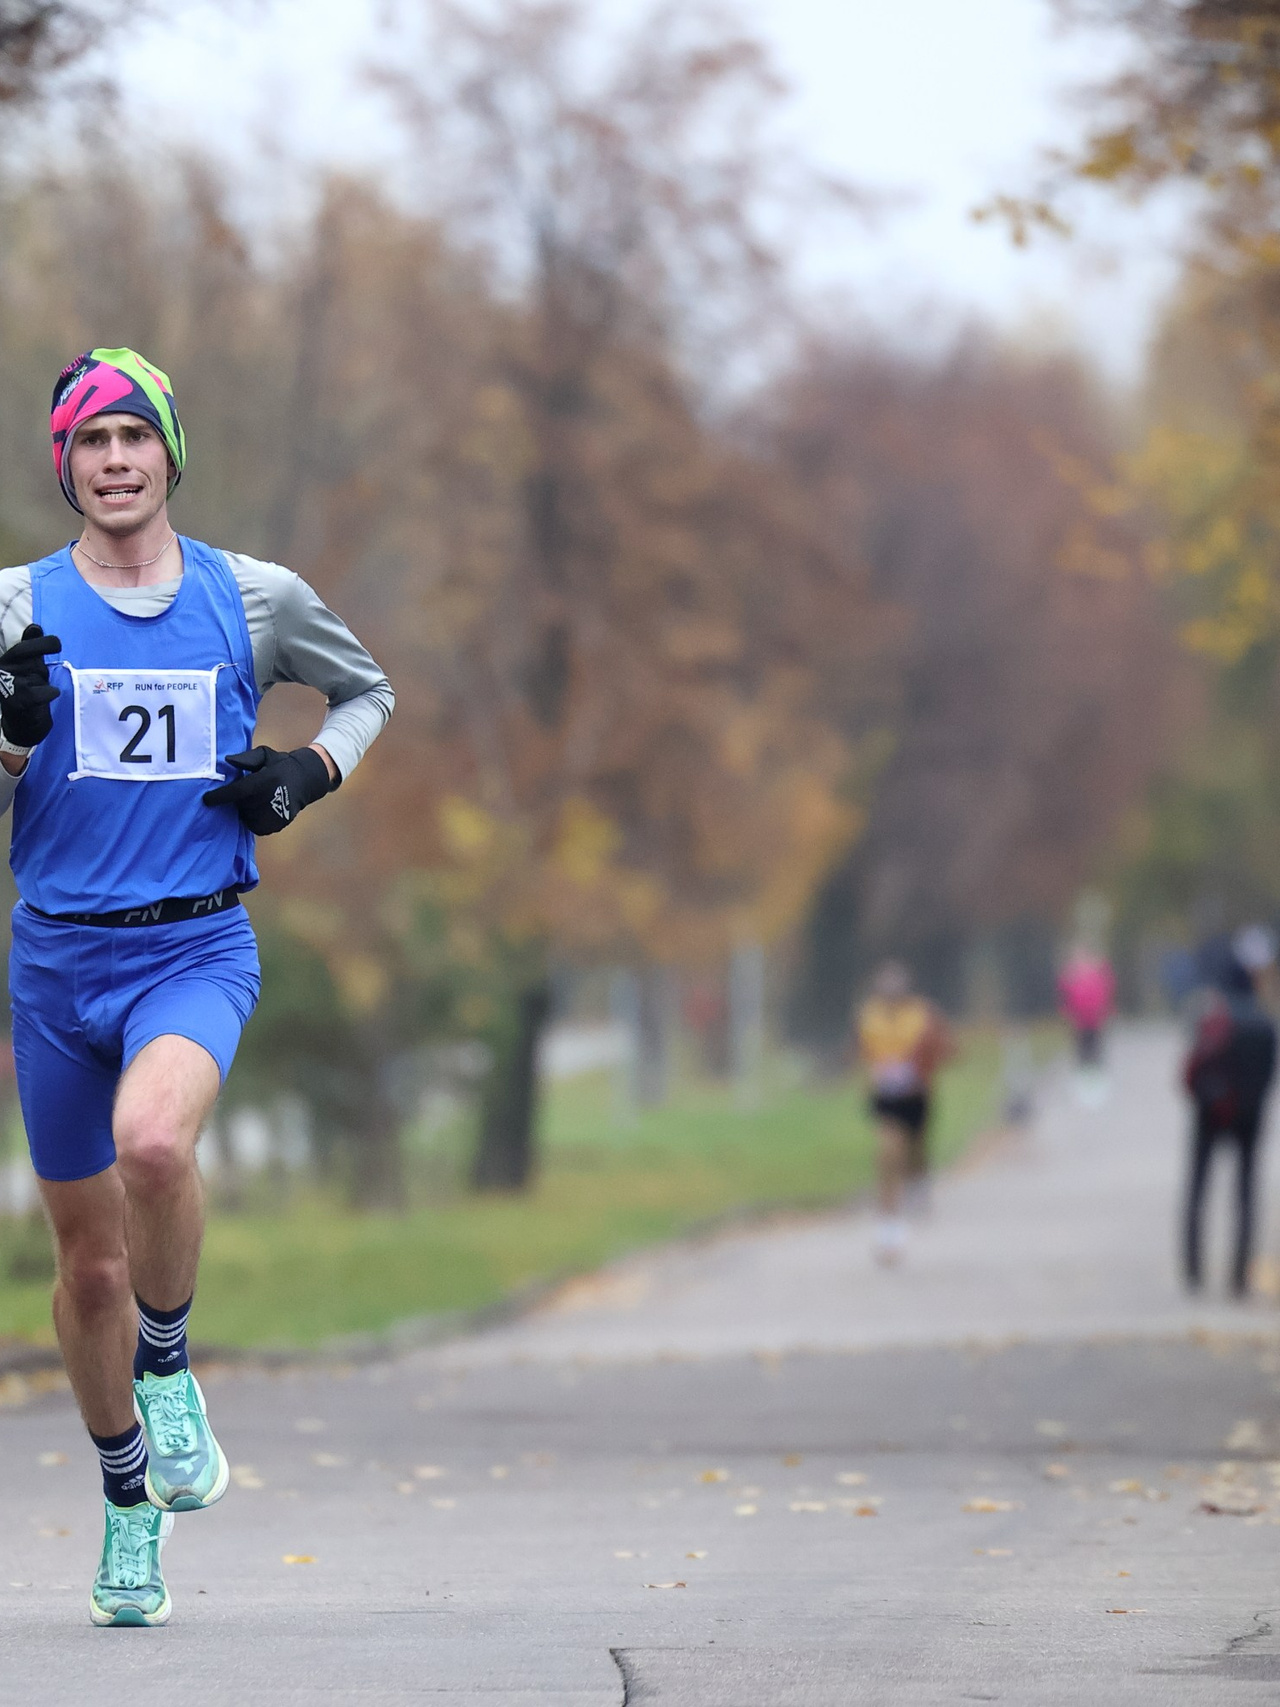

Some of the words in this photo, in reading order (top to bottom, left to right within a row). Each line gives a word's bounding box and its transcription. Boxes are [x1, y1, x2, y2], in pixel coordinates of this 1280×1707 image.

[106, 682, 124, 691] RFP
[135, 683, 153, 691] RUN
[154, 683, 165, 691] for
[166, 682, 198, 691] PEOPLE
[118, 704, 176, 764] 21
